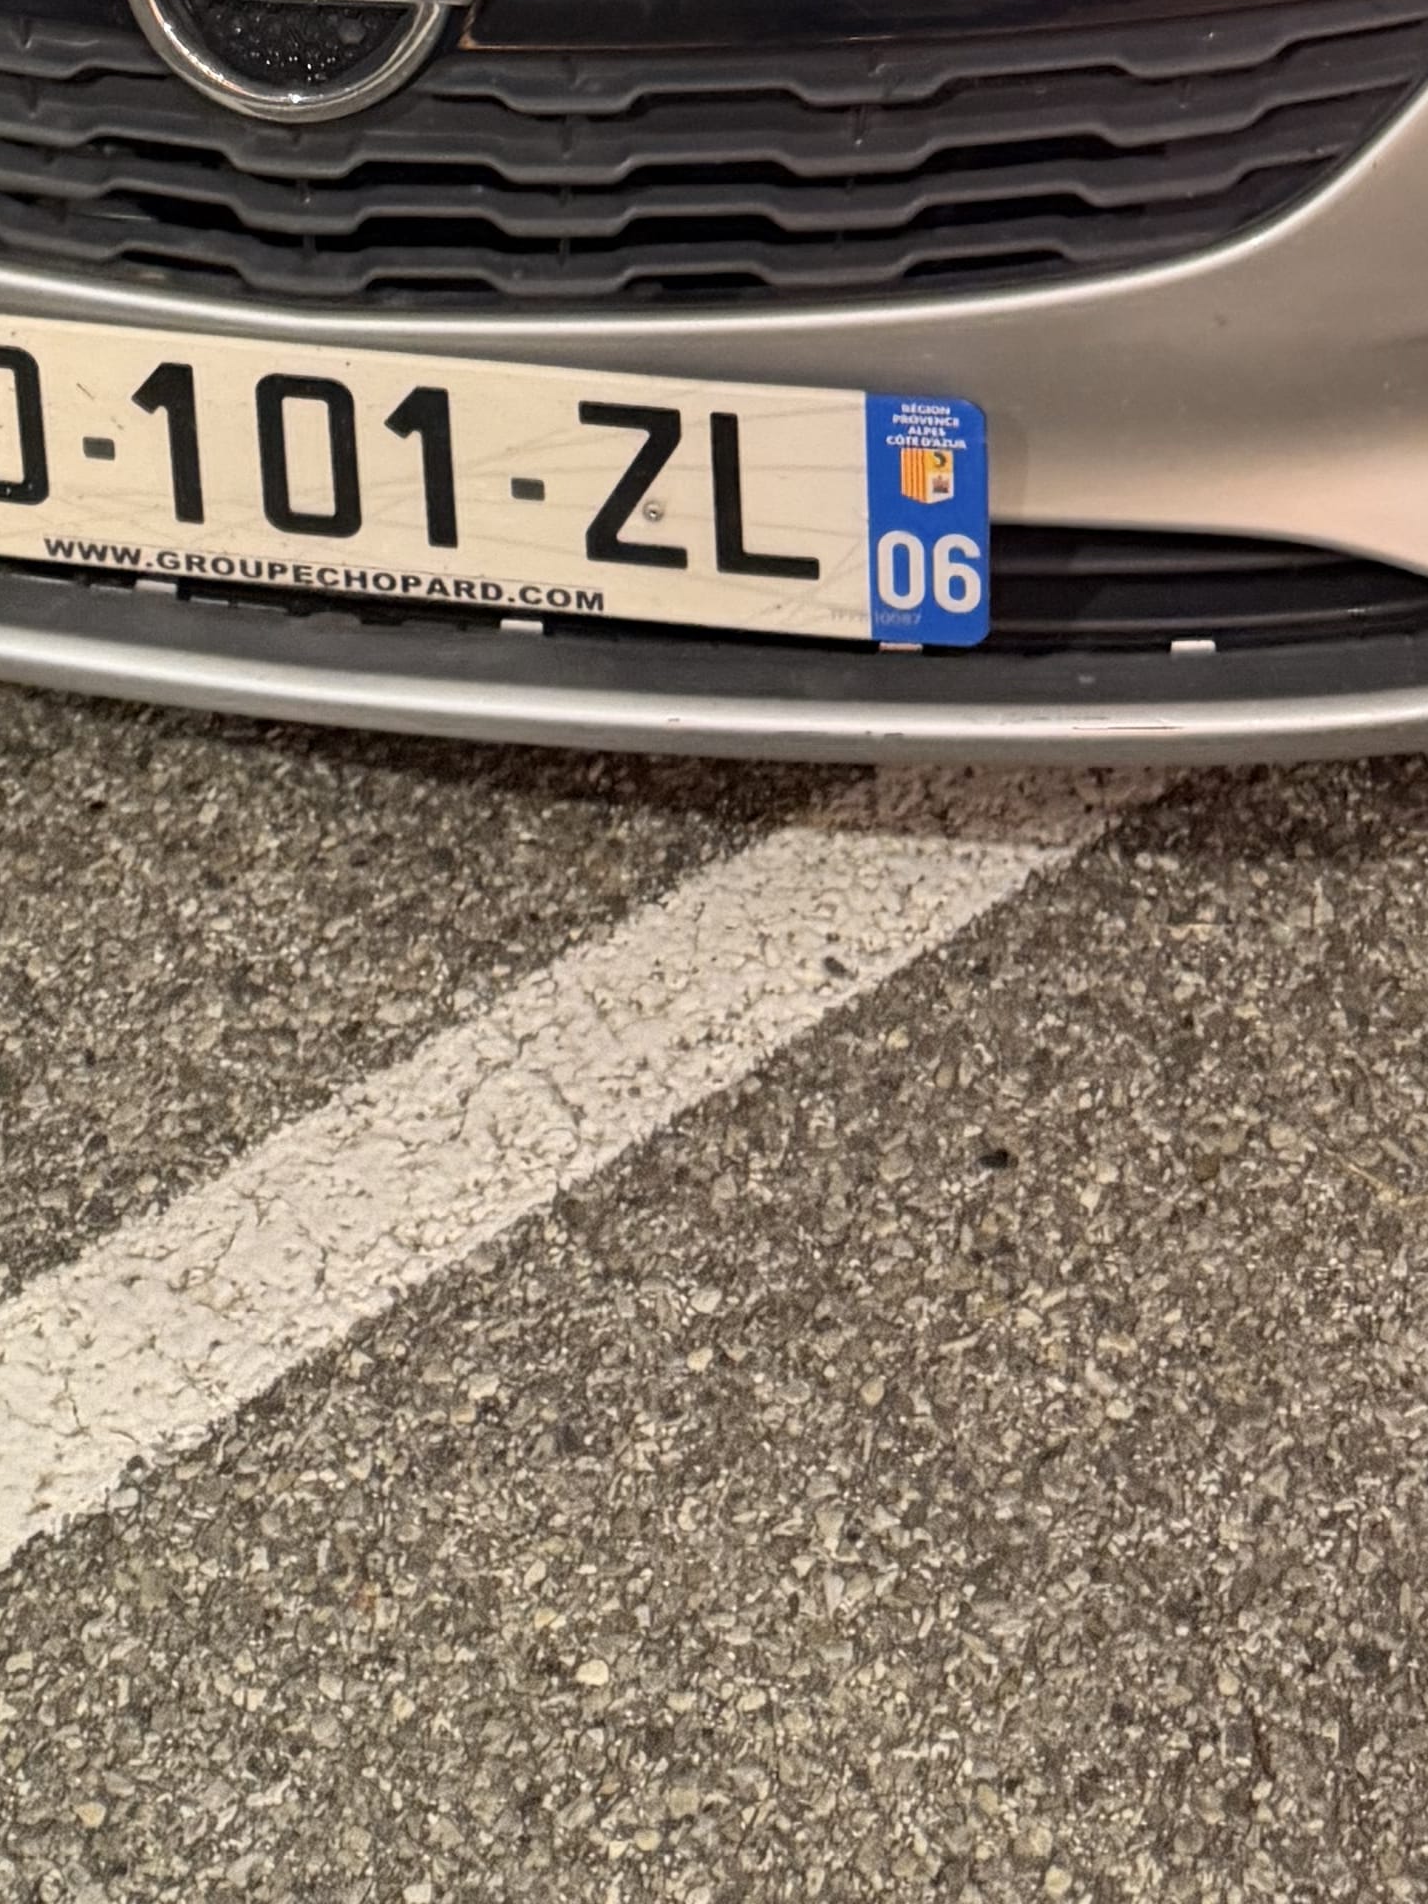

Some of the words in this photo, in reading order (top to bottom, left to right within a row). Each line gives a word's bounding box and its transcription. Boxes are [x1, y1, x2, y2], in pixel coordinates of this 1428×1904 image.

[893, 414, 960, 428] PROVENCE
[908, 426, 947, 437] ALPES
[44, 537, 605, 611] WWW.GROUPECHOPARD.COM
[877, 530, 981, 614] 06
